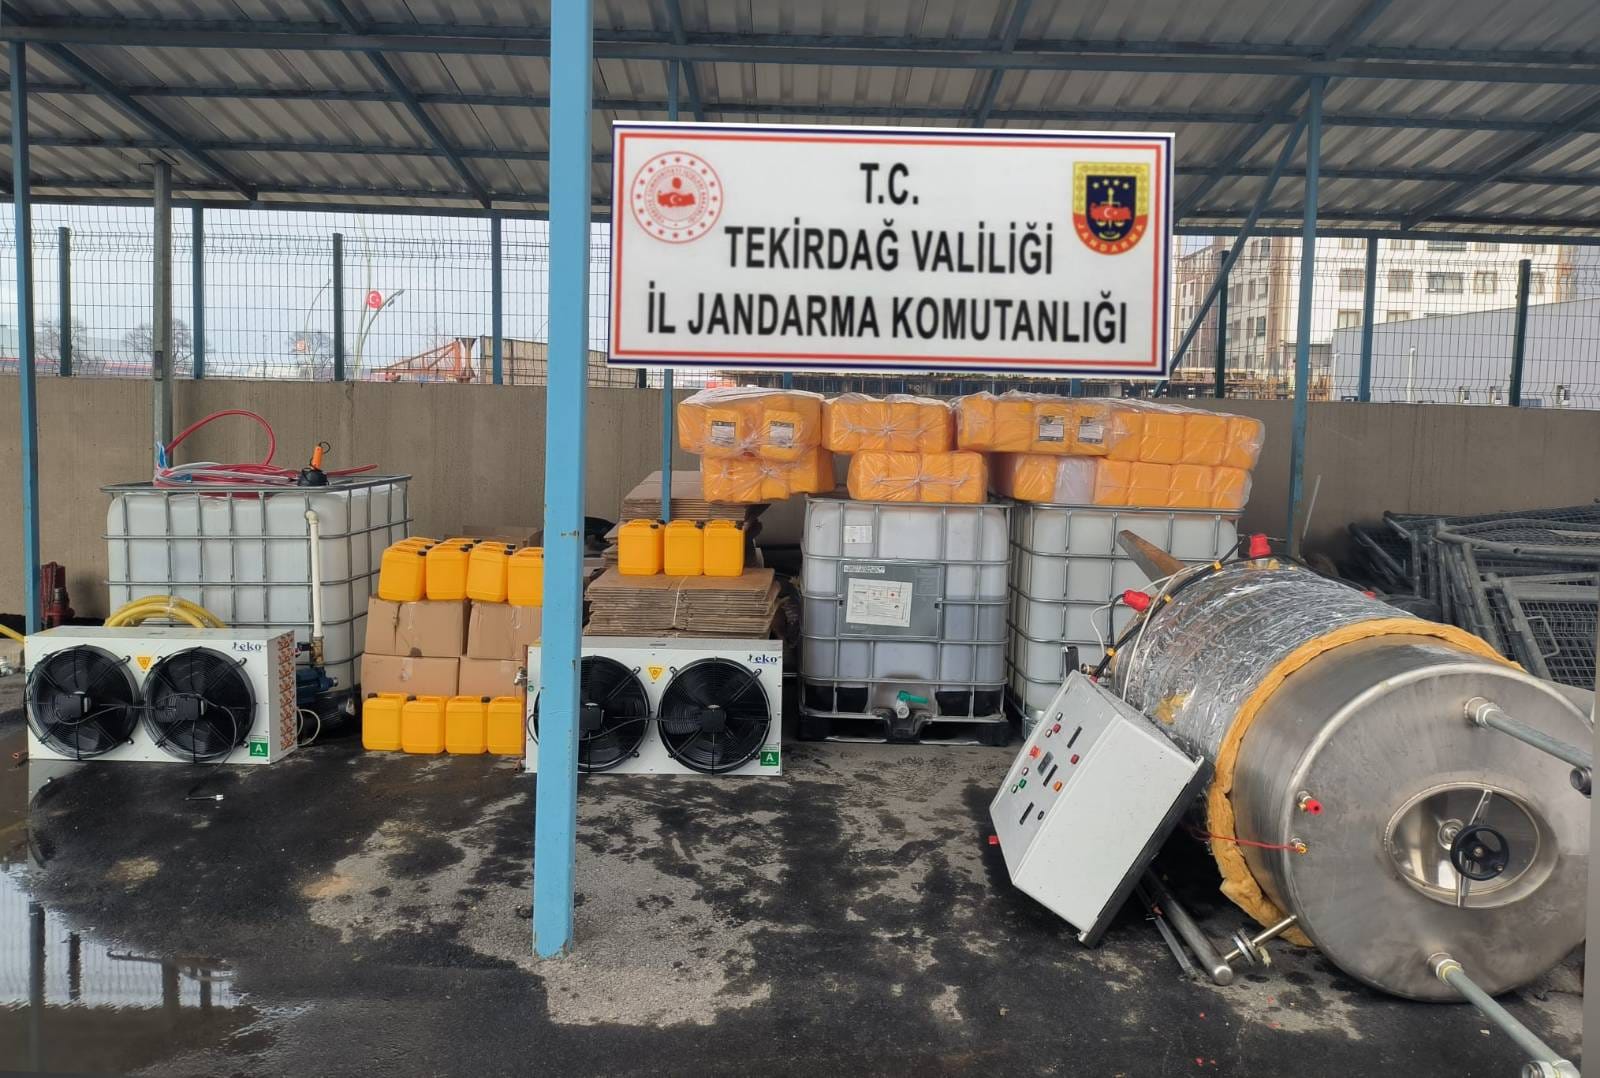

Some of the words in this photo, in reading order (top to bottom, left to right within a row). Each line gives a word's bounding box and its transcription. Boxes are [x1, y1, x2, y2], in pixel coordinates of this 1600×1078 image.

[860, 162, 919, 205] T.C.
[724, 217, 899, 272] TEKİRDAĞ
[911, 221, 1053, 275] VALİLİĞİ
[648, 281, 676, 334] İL
[687, 292, 880, 338] JANDARMA
[892, 291, 1127, 344] KOMUTANLIĞI
[255, 744, 263, 753] A
[766, 752, 775, 762] A
